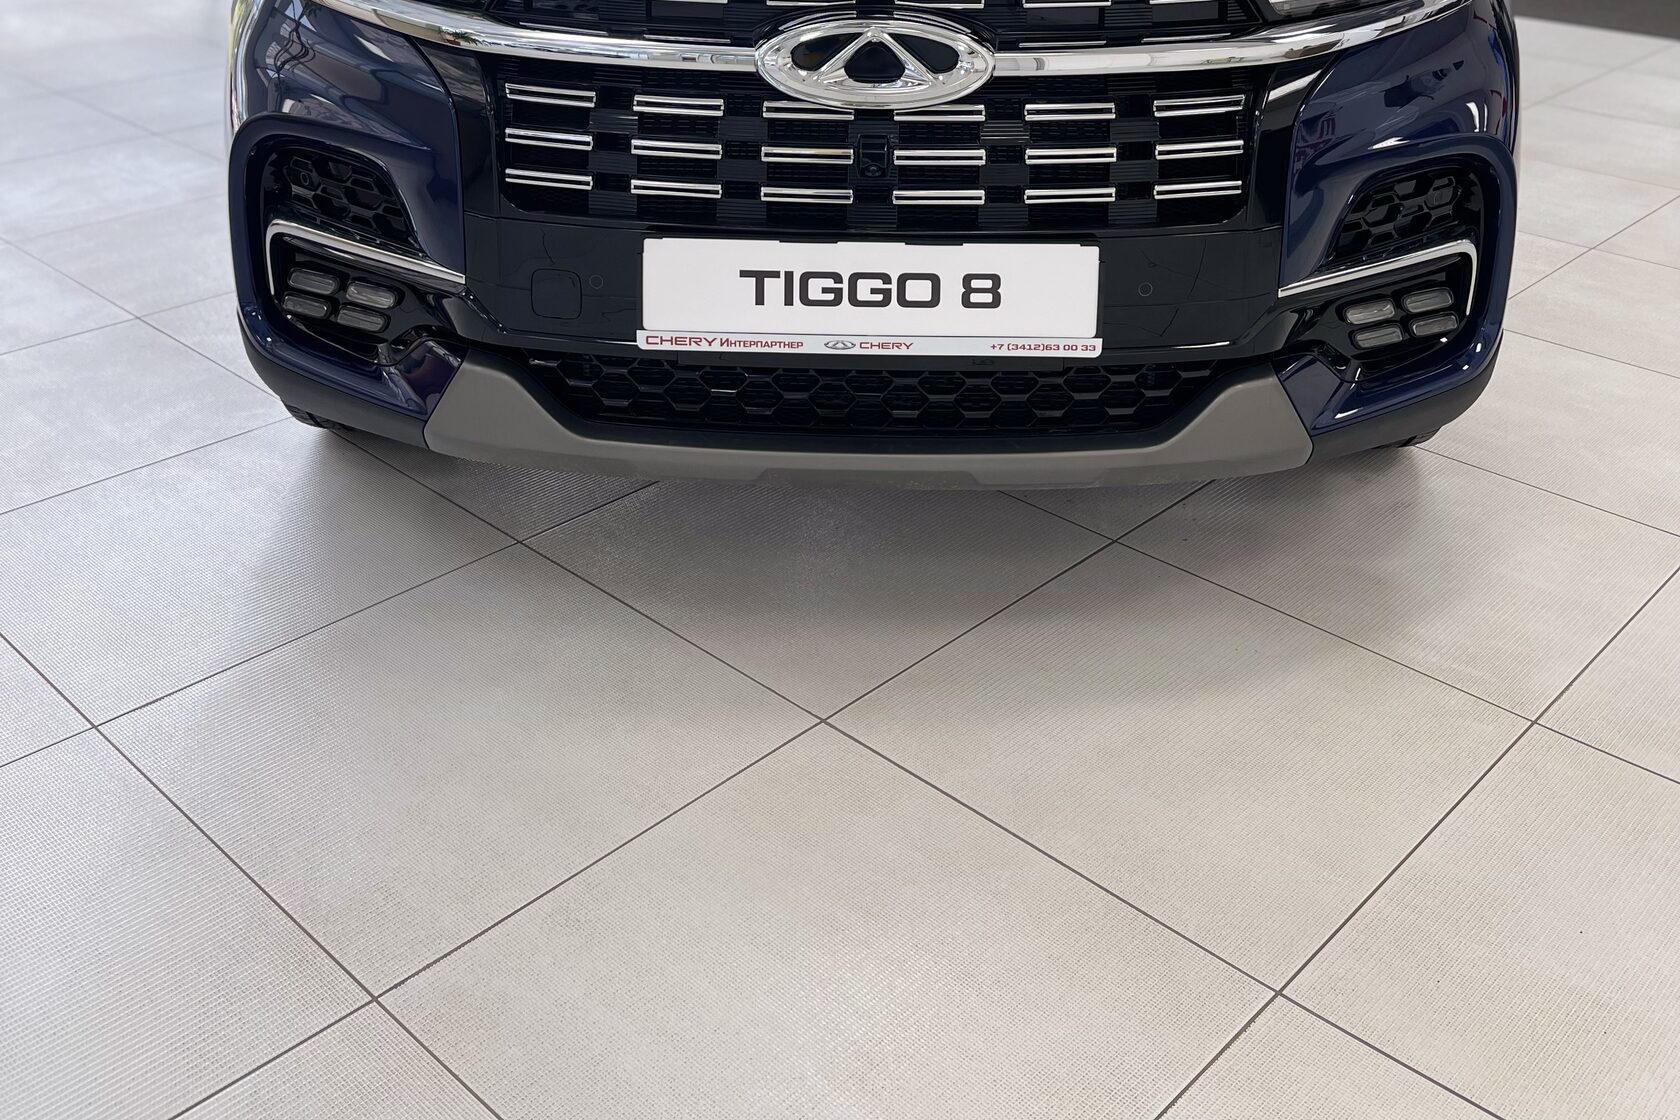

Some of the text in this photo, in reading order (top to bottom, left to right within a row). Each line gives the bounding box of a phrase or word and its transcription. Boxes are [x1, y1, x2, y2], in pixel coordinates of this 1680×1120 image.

[739, 269, 1002, 309] TIGGO 8
[645, 334, 717, 347] CHERY
[859, 342, 914, 351] CHERY
[990, 342, 1097, 353] +7 (3412)63 00 33
